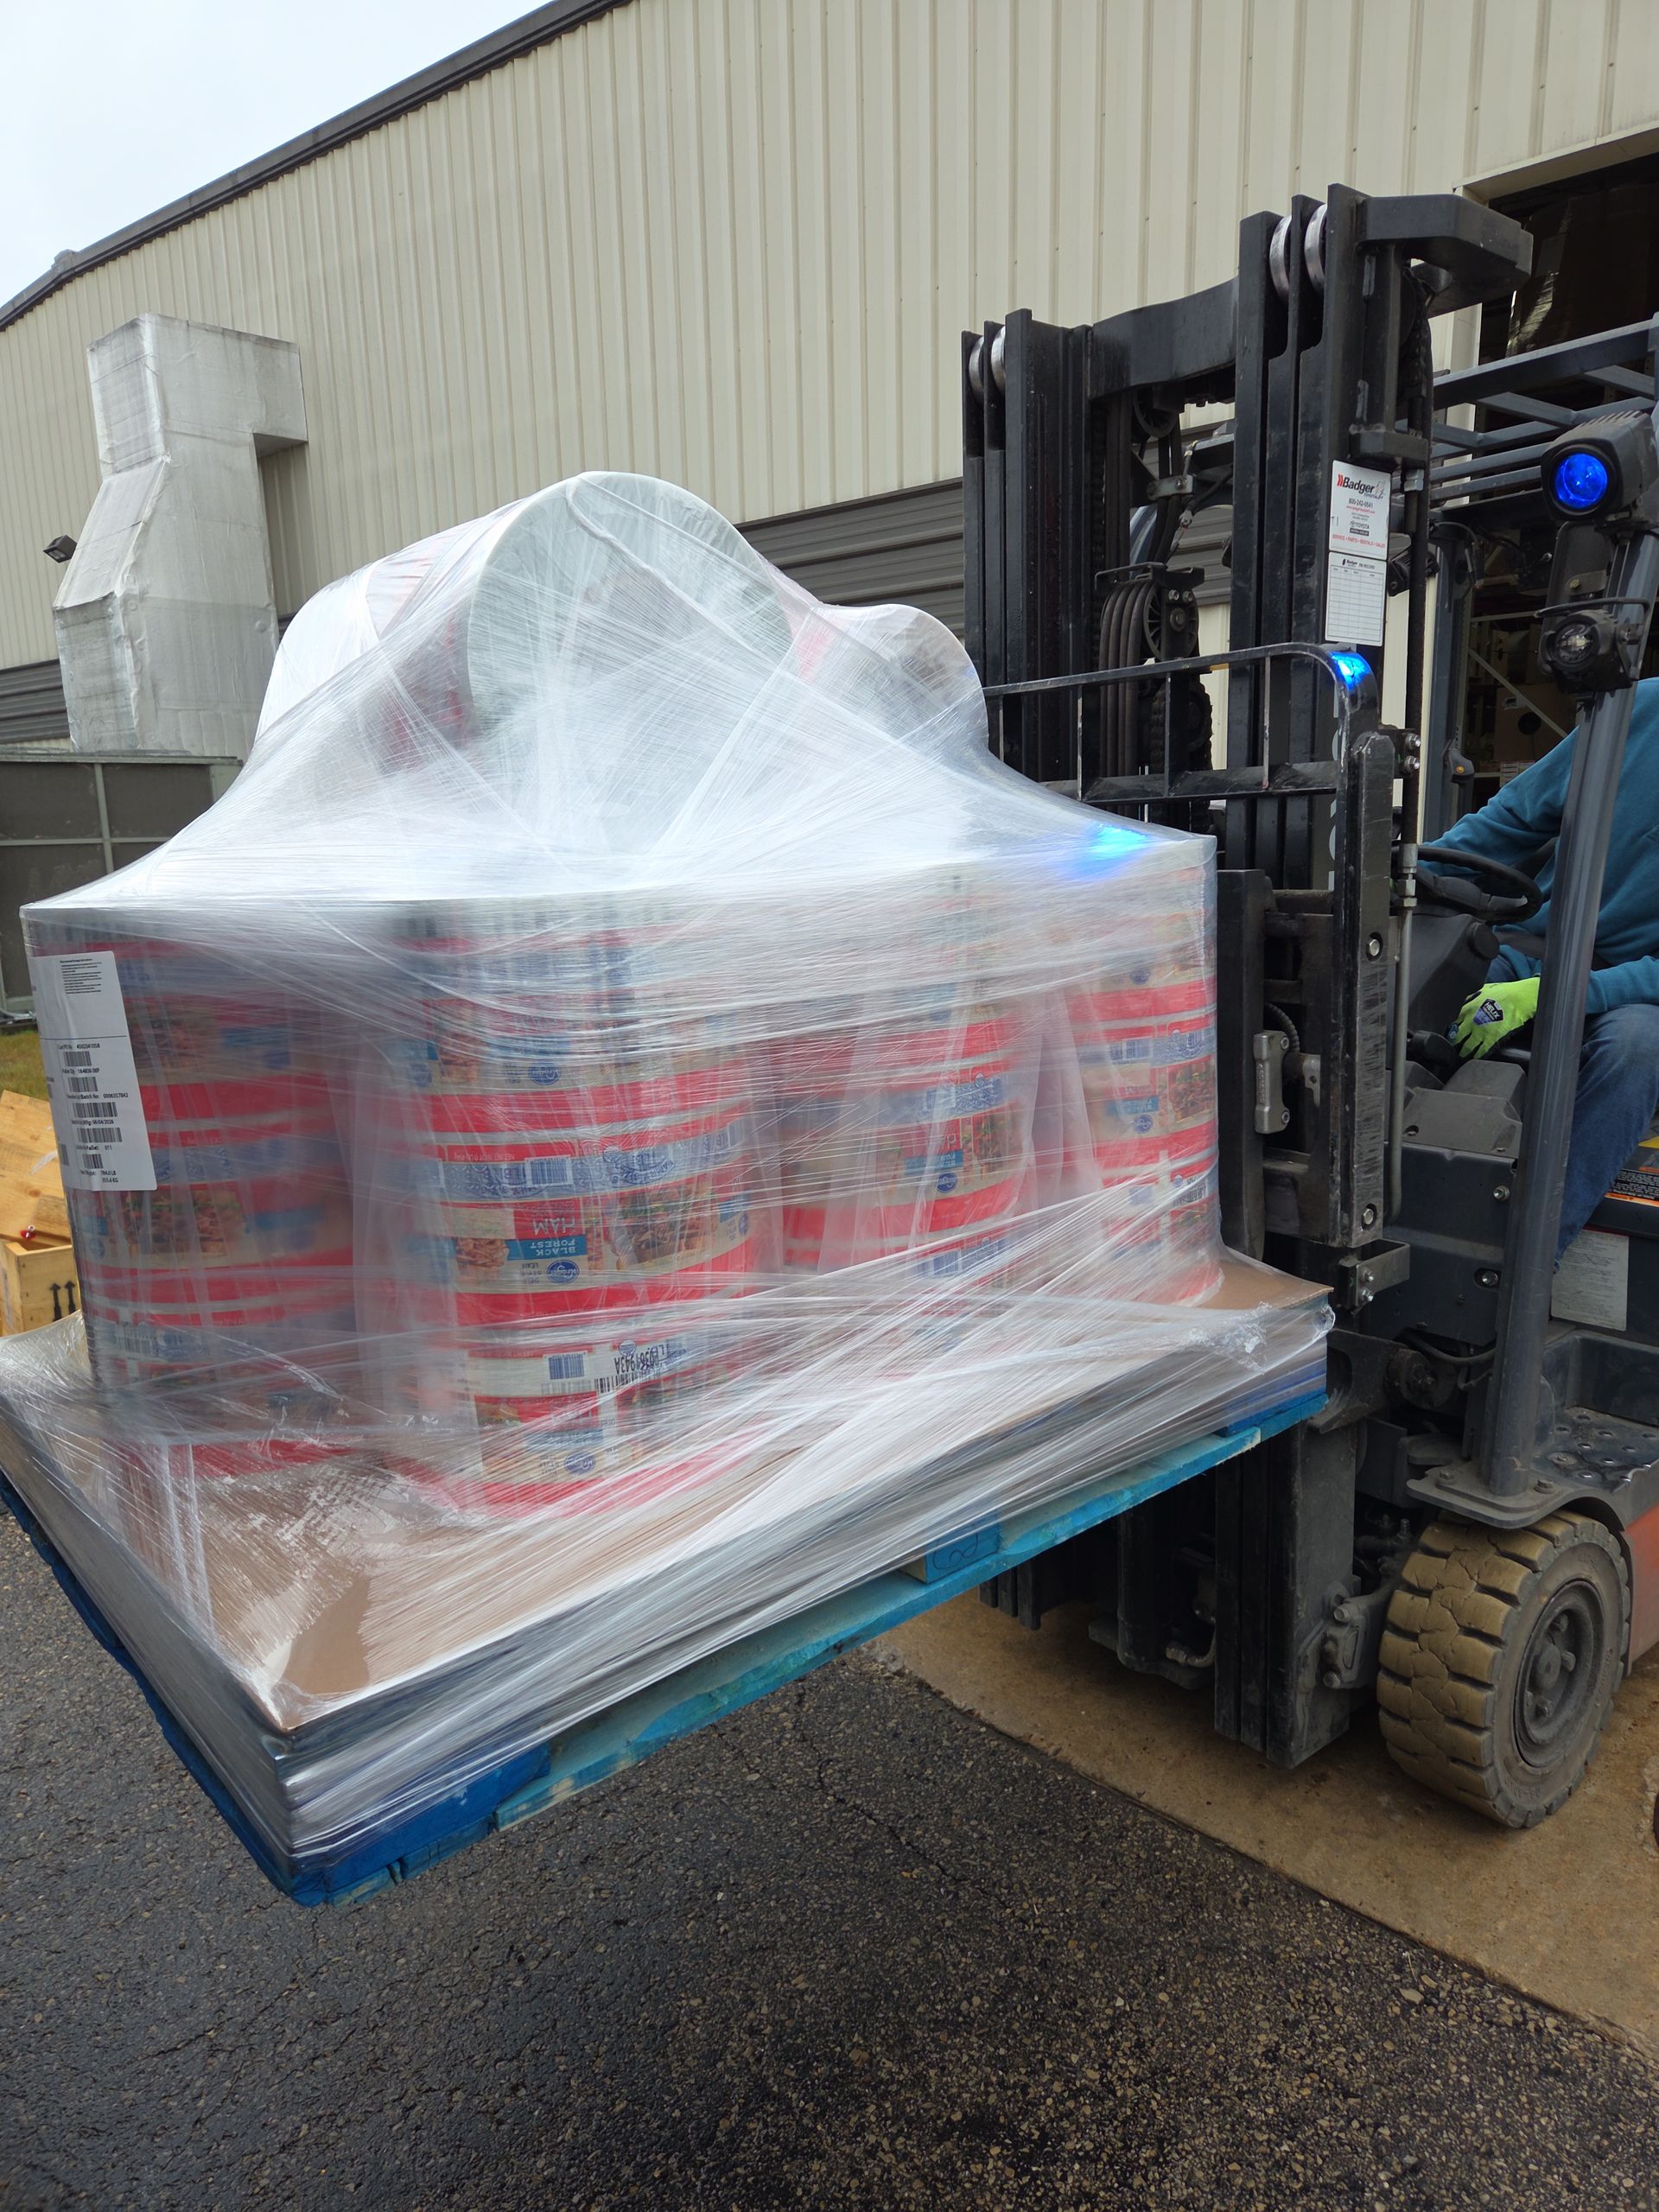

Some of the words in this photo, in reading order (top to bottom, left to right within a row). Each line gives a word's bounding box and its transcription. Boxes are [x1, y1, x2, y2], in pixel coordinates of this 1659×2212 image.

[1343, 477, 1375, 494] Badger
[1484, 1002, 1500, 1019] HELIX
[532, 1217, 575, 1236] HAM
[530, 1238, 575, 1249] FOREST
[536, 1246, 575, 1256] BLACK
[547, 1263, 577, 1280] Kroger
